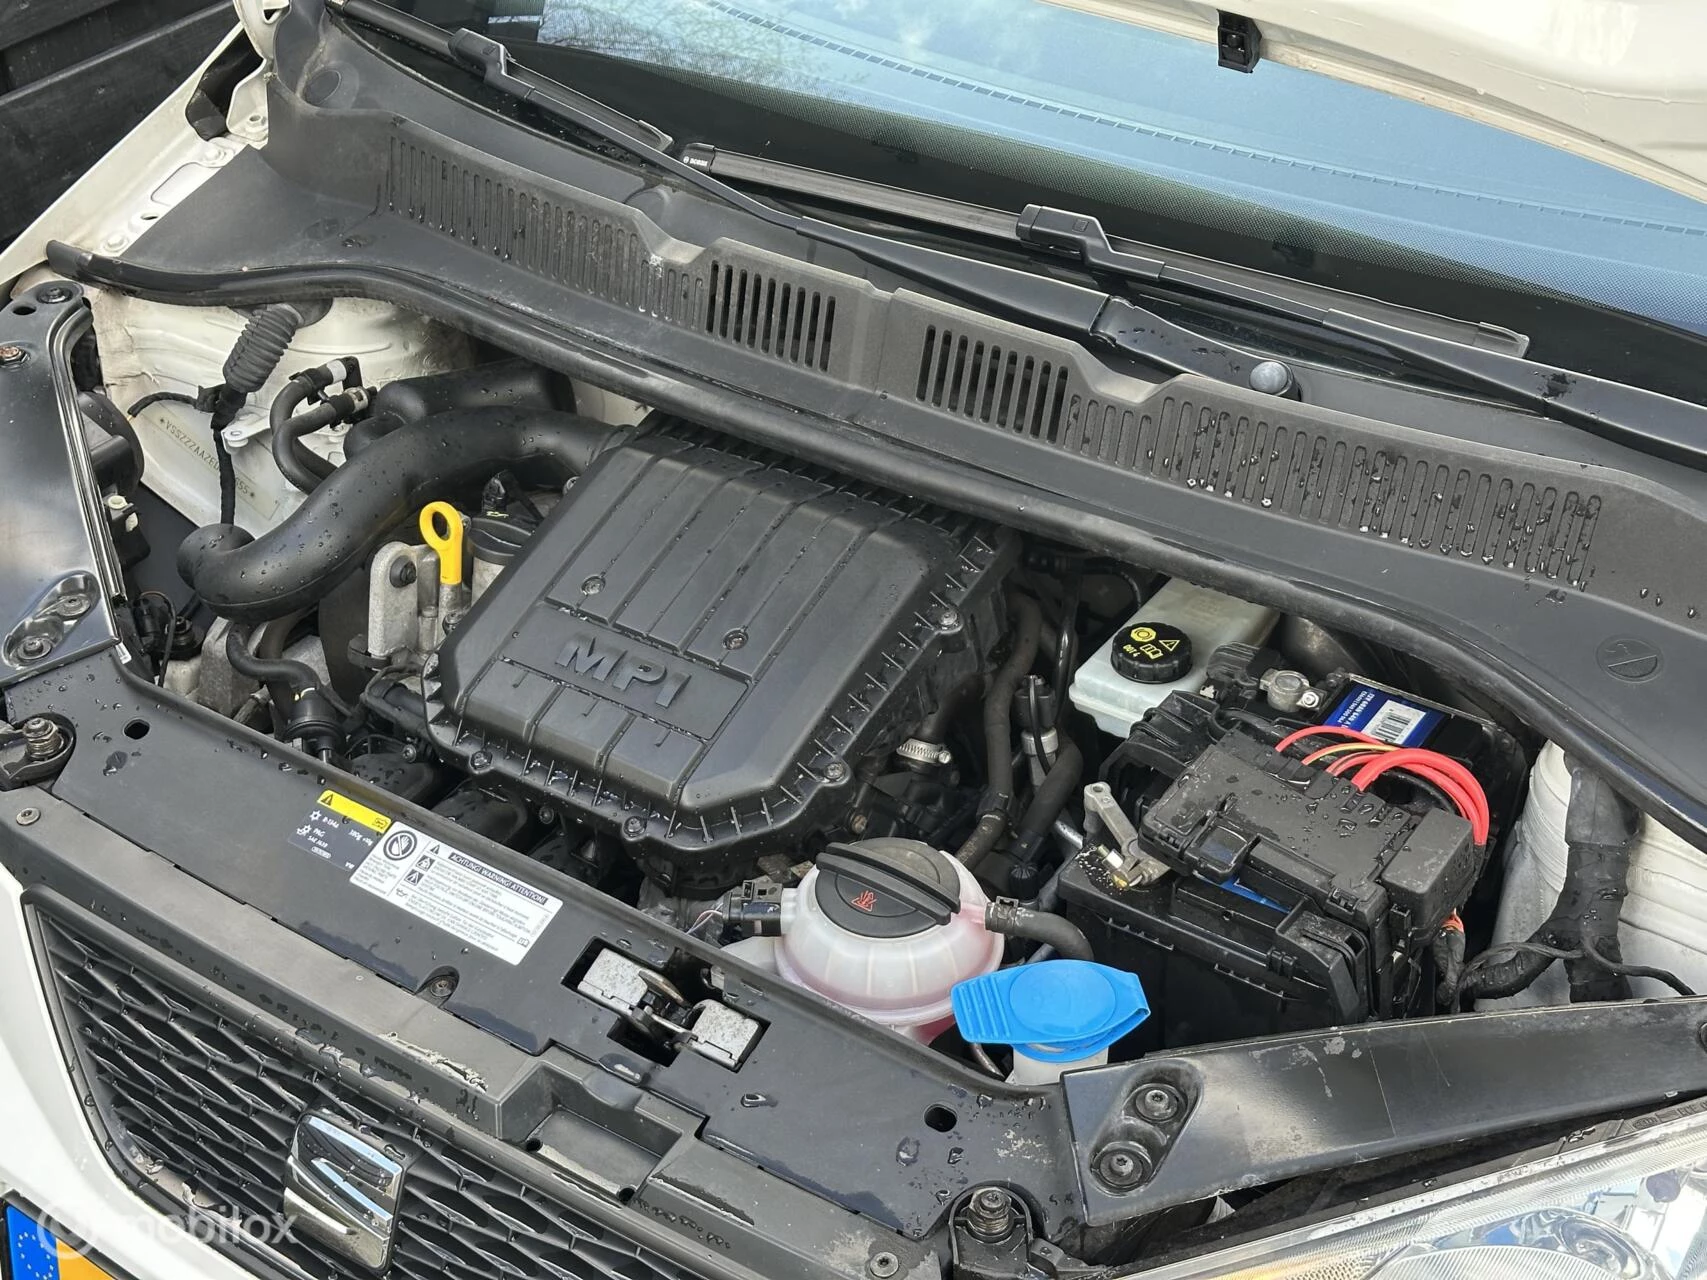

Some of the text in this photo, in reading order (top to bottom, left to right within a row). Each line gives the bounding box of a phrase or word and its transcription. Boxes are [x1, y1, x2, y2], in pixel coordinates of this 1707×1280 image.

[554, 634, 692, 709] MPI
[451, 854, 546, 903] ACHTUNG! WARNING! ATTENTION!
